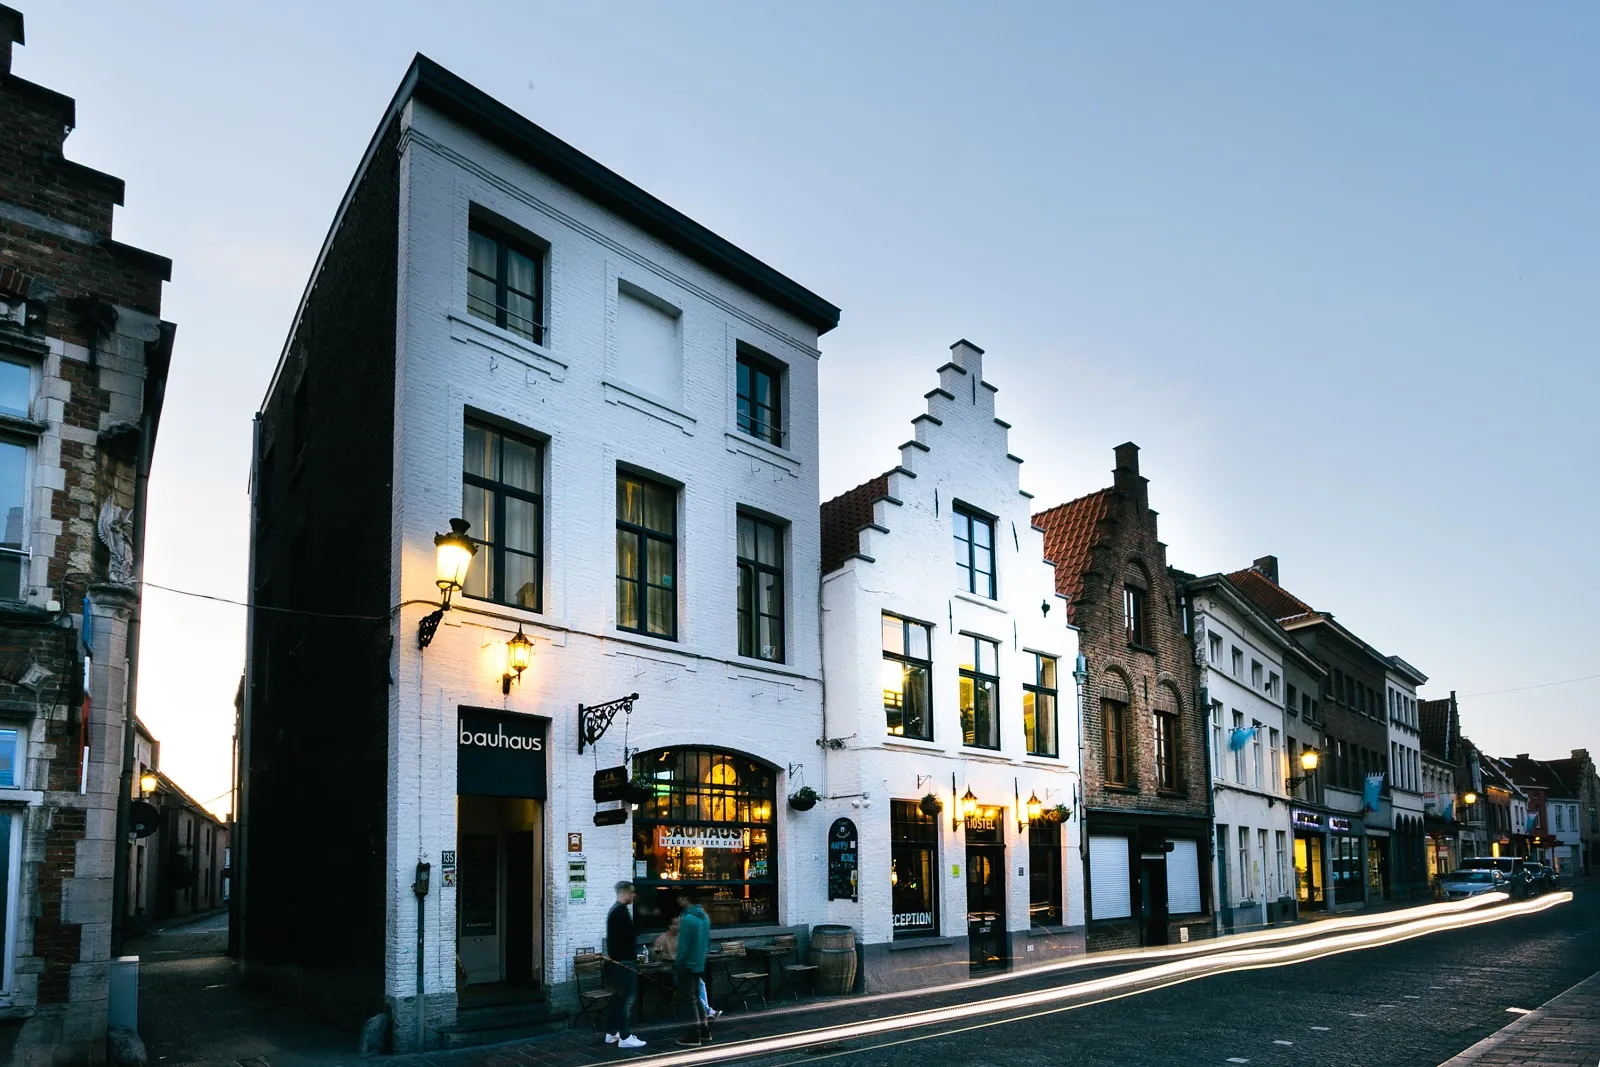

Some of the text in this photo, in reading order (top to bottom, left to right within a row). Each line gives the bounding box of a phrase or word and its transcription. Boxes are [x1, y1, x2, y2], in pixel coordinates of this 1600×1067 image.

[459, 718, 542, 751] bauhaus
[443, 852, 454, 863] 135
[892, 912, 932, 926] CEPTION
